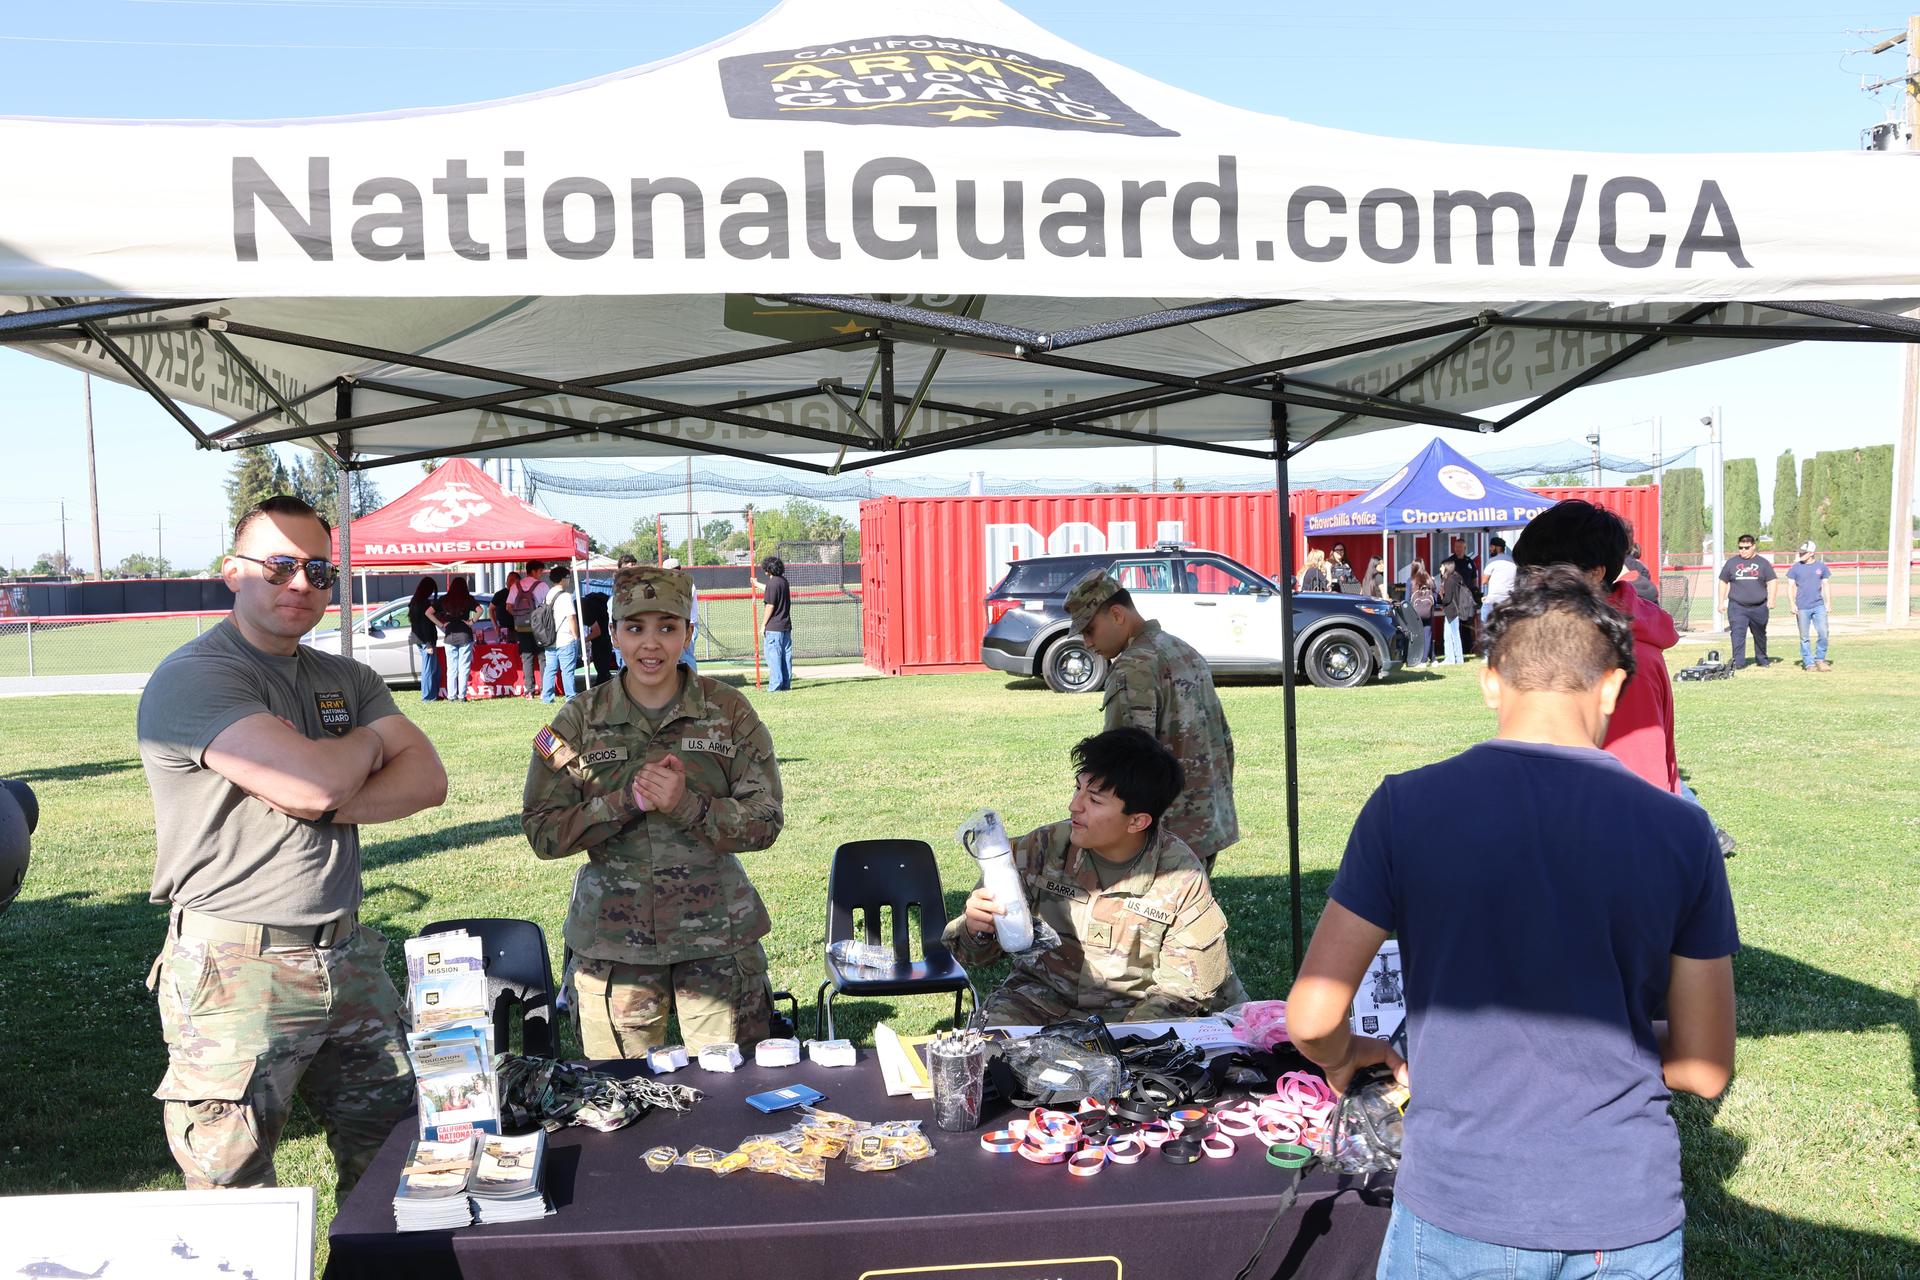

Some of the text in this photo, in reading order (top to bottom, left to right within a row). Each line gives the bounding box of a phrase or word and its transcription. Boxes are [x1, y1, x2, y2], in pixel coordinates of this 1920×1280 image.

[794, 40, 1030, 64] CALIFORNIA
[770, 55, 1066, 90] ARMY
[772, 70, 1095, 110] NATIONAL
[773, 83, 1112, 121] GUARD
[232, 150, 1753, 269] NationalGuard.com/CA
[1309, 511, 1377, 530] Chowchilla Police
[1402, 508, 1508, 523] Chowchilla
[365, 540, 525, 555] MARINES.COM
[321, 700, 345, 709] ARMY
[323, 714, 350, 723] GUARD
[688, 740, 731, 755] U.S. ARMY
[582, 750, 617, 765] TURCIOS
[1046, 881, 1075, 898] IBARRA
[1127, 900, 1170, 921] U.S. ARMY
[428, 966, 459, 975] MISSION
[420, 1054, 460, 1064] EDUCATION
[439, 1124, 473, 1133] CALIFORNIA
